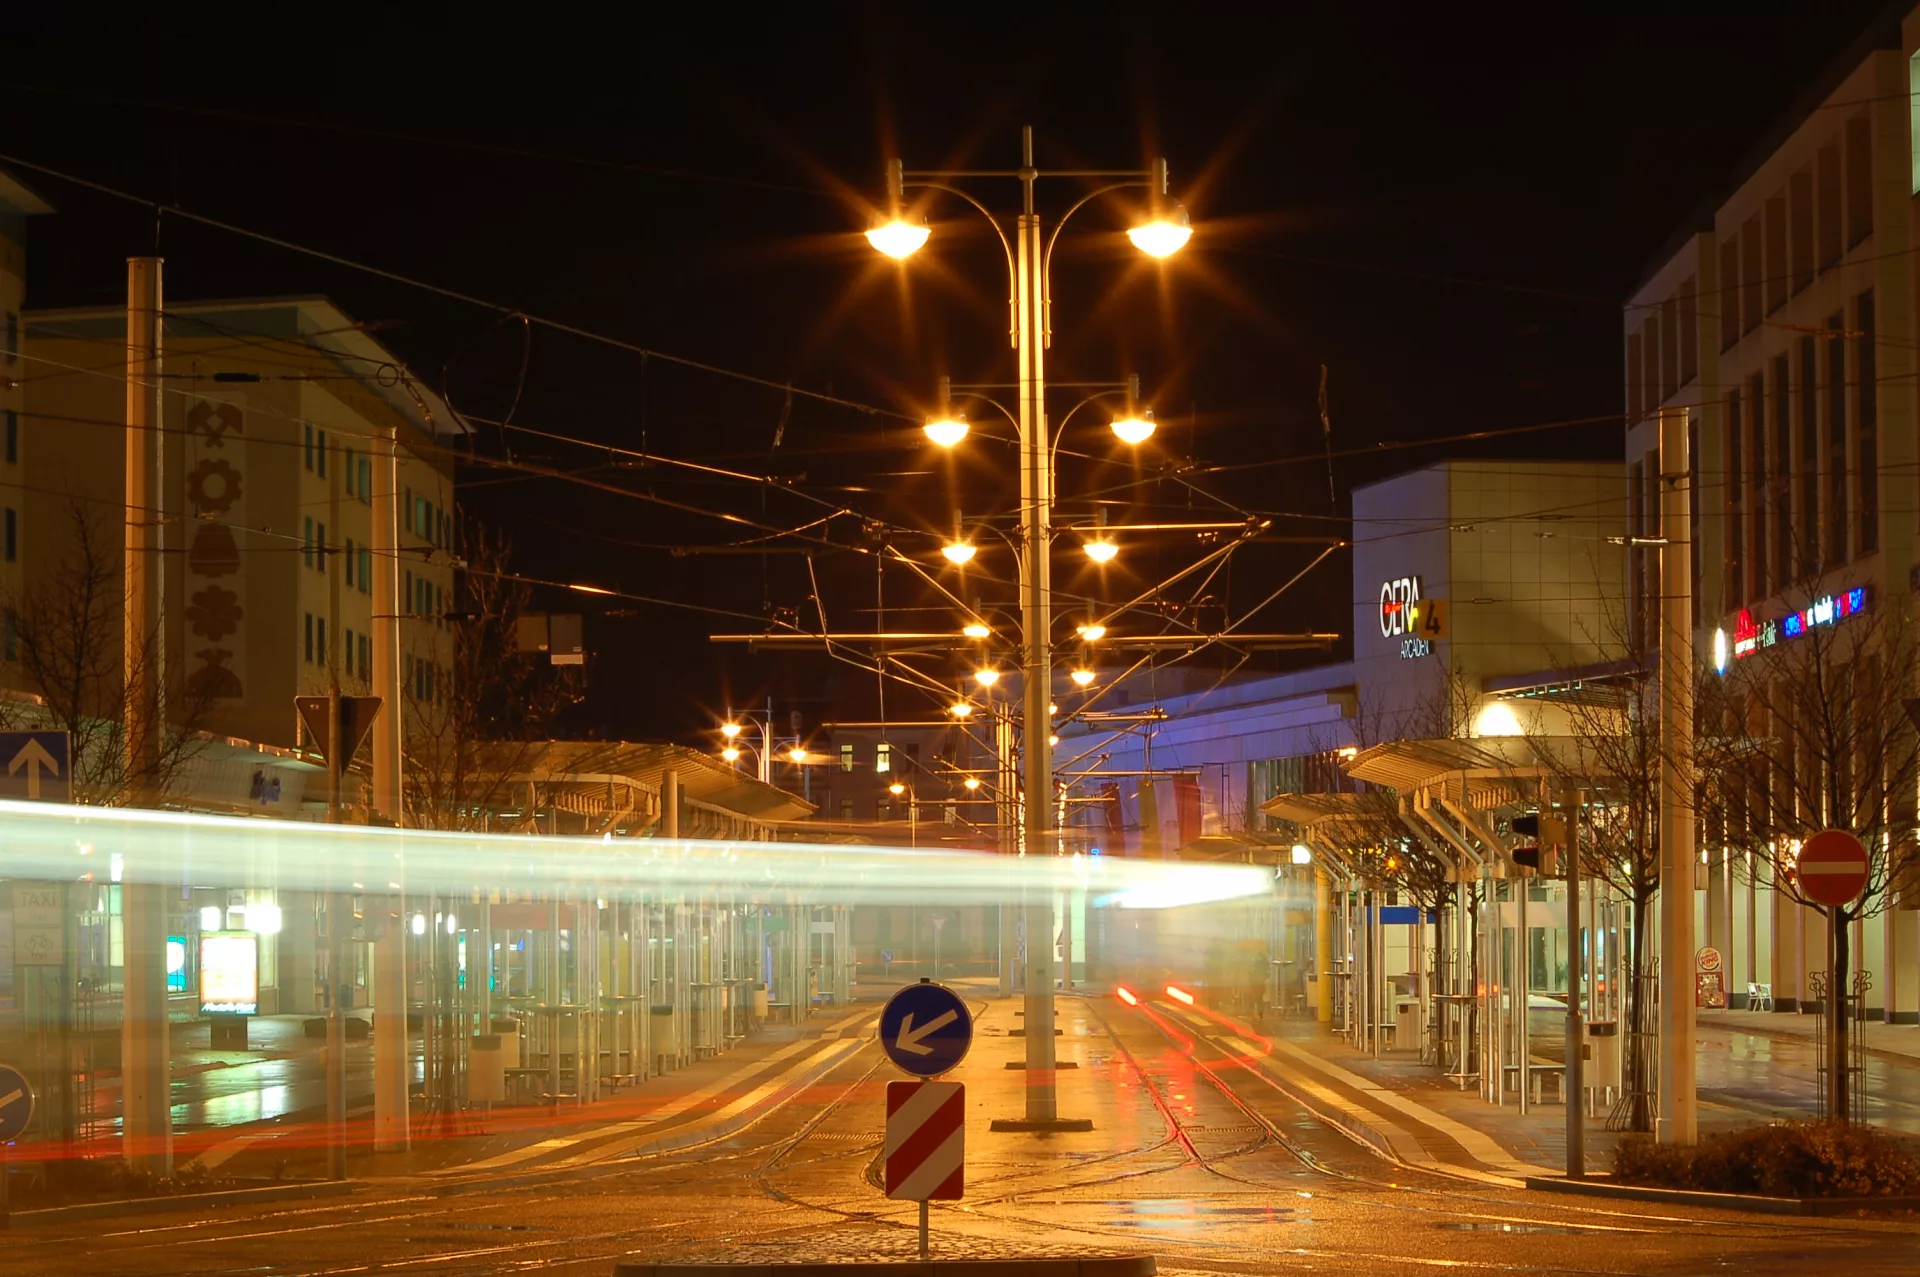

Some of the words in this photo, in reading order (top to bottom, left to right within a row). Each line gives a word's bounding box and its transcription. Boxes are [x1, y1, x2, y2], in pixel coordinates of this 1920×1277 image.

[1425, 600, 1441, 635] 4
[1401, 638, 1429, 659] ARCADEN
[20, 892, 57, 908] TAXI
[1702, 956, 1719, 966] KING
